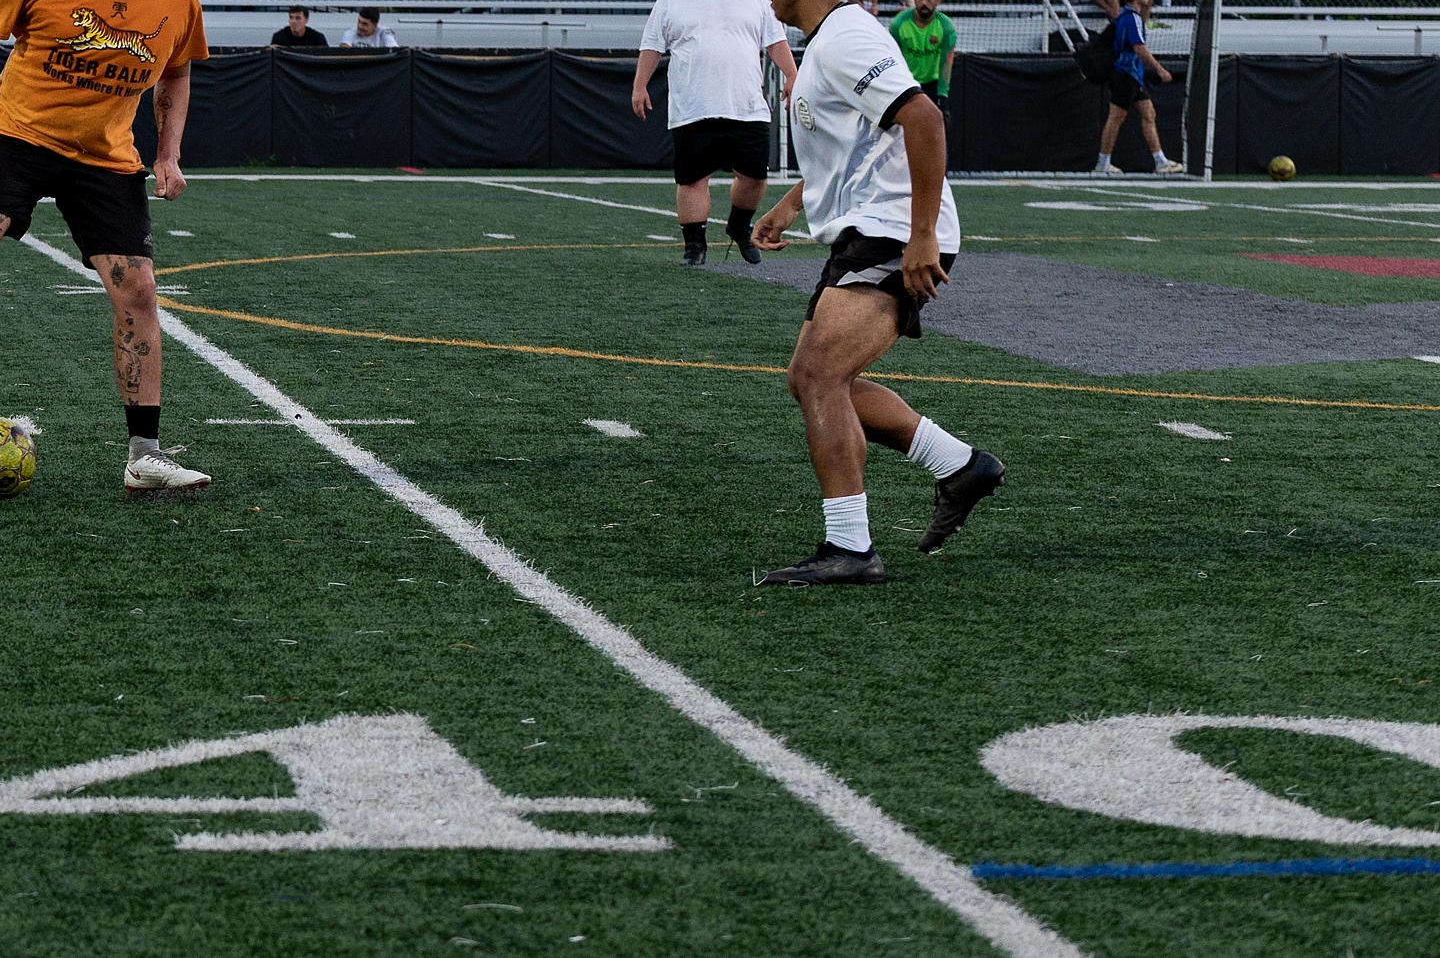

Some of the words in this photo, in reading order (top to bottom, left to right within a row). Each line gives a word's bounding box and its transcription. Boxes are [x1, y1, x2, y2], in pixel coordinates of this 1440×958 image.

[43, 62, 74, 85] Works
[76, 75, 113, 94] Where
[114, 85, 124, 97] It
[48, 47, 99, 76] TIGER
[104, 63, 152, 84] BALM
